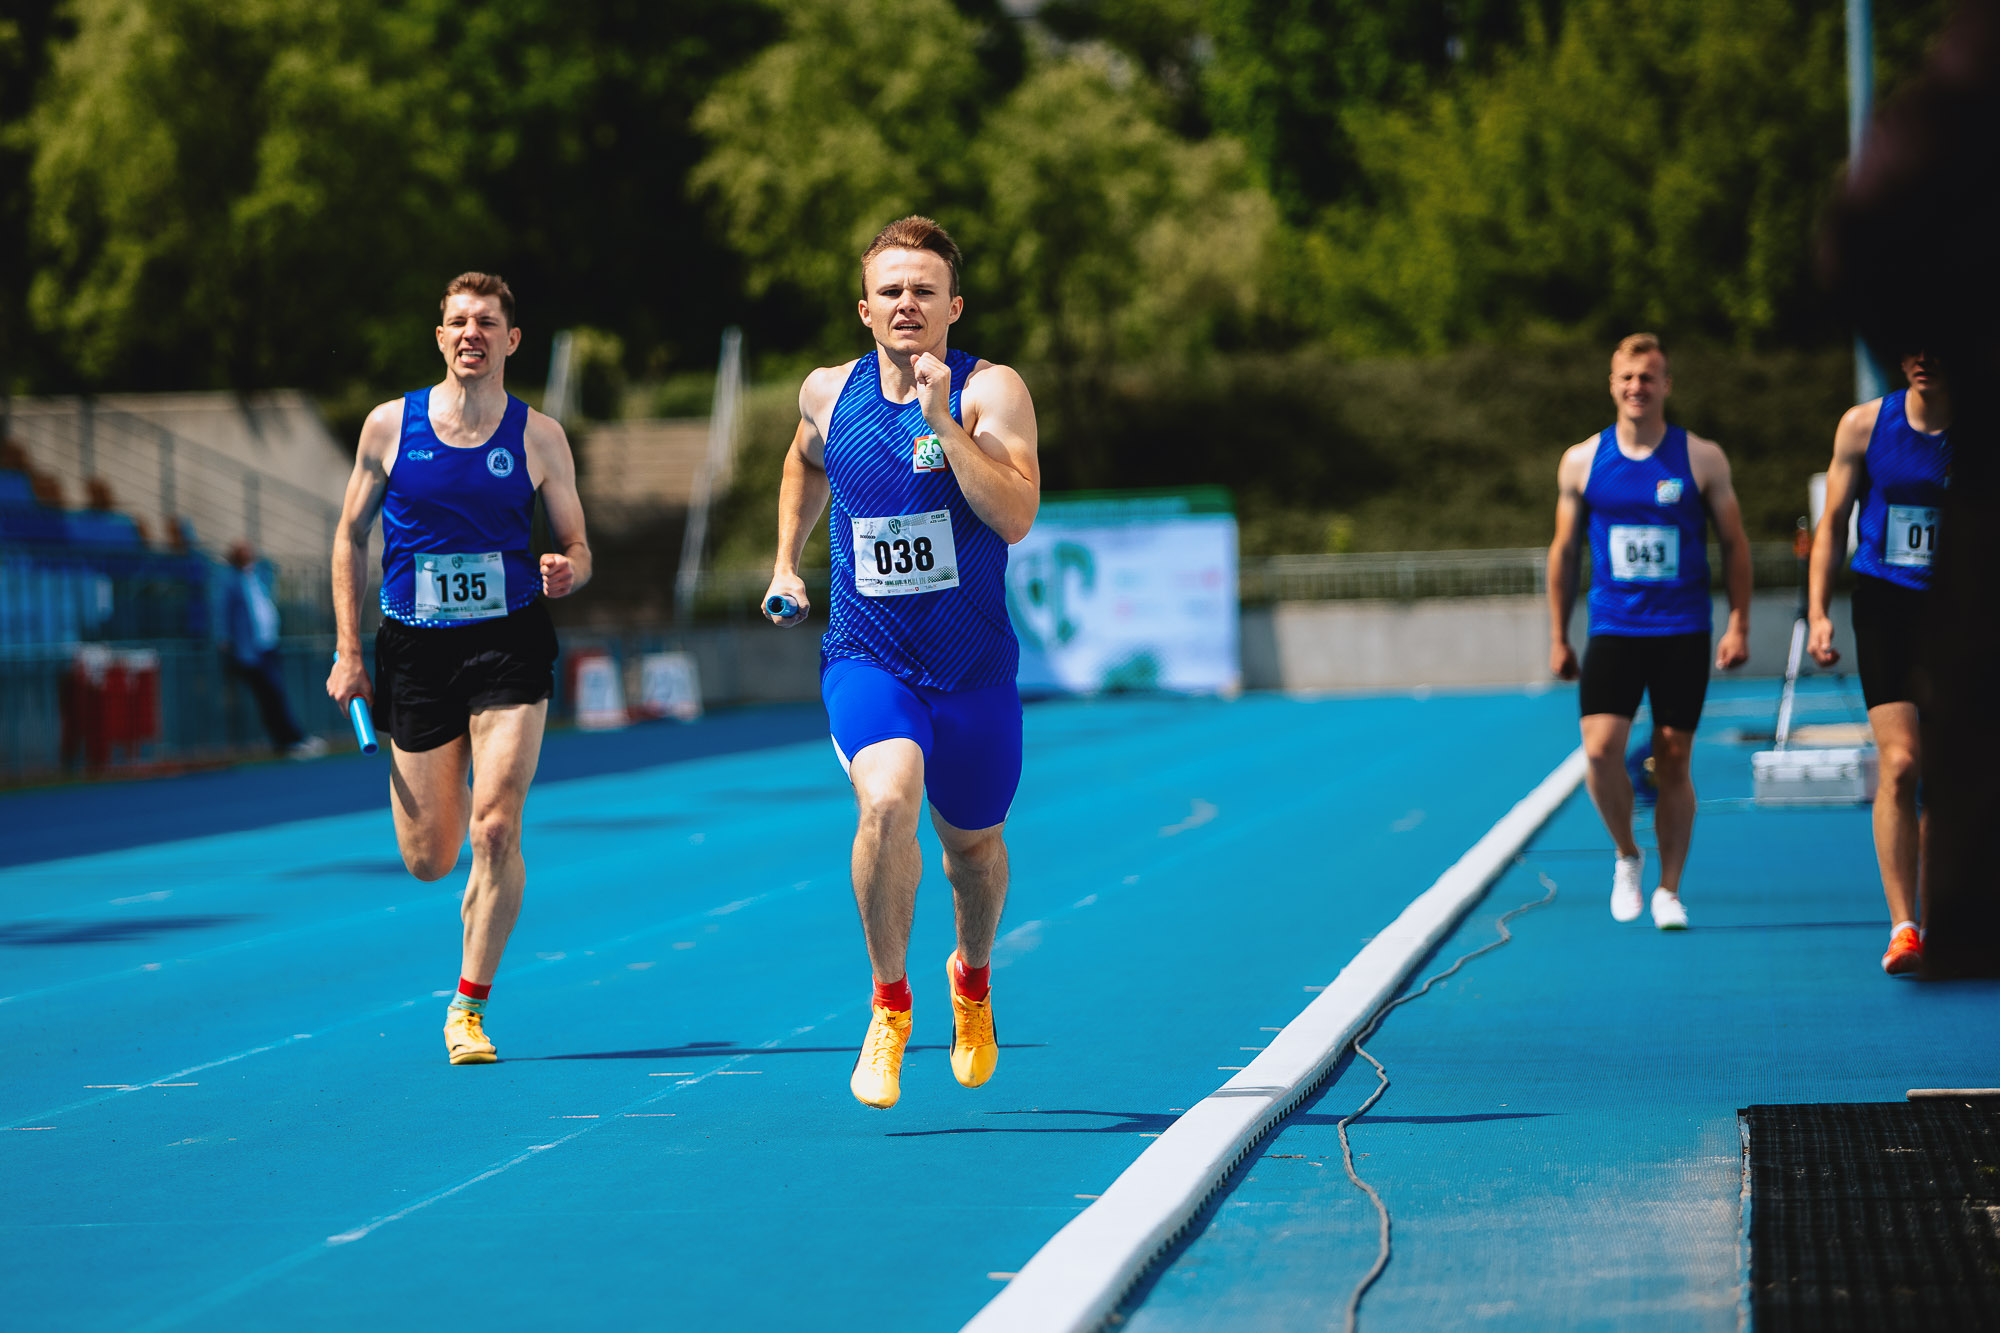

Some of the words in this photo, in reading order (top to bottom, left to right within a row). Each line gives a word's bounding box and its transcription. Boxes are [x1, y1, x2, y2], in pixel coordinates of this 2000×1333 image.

[1908, 523, 1937, 552] 01
[873, 536, 935, 576] 038
[1626, 541, 1666, 565] 043
[436, 571, 487, 603] 135
